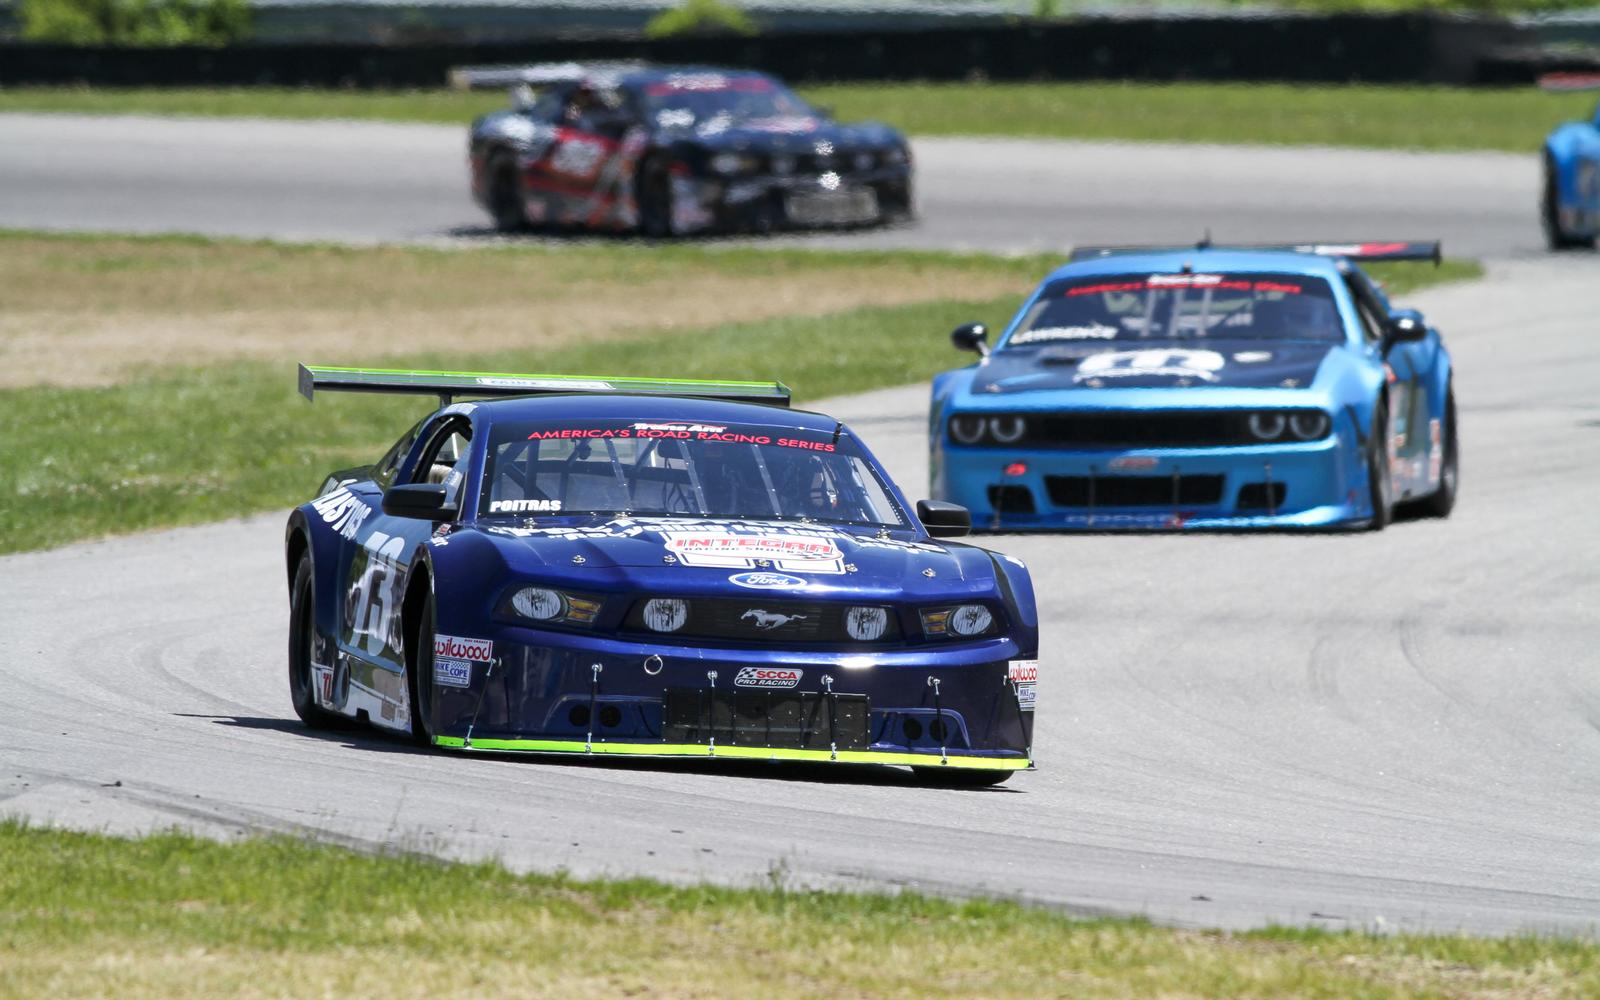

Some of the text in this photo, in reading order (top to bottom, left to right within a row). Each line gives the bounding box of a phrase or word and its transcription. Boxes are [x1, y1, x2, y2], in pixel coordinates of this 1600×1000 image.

[528, 429, 835, 452] AMERICA'S ROAD RACING SERIES
[489, 499, 562, 513] POITRAS
[676, 538, 833, 553] INTEGRA
[746, 574, 790, 585] Ford
[435, 637, 492, 661] wilwood
[450, 668, 468, 678] COPE
[756, 670, 798, 679] SCCA
[1009, 663, 1037, 681] wilwoo
